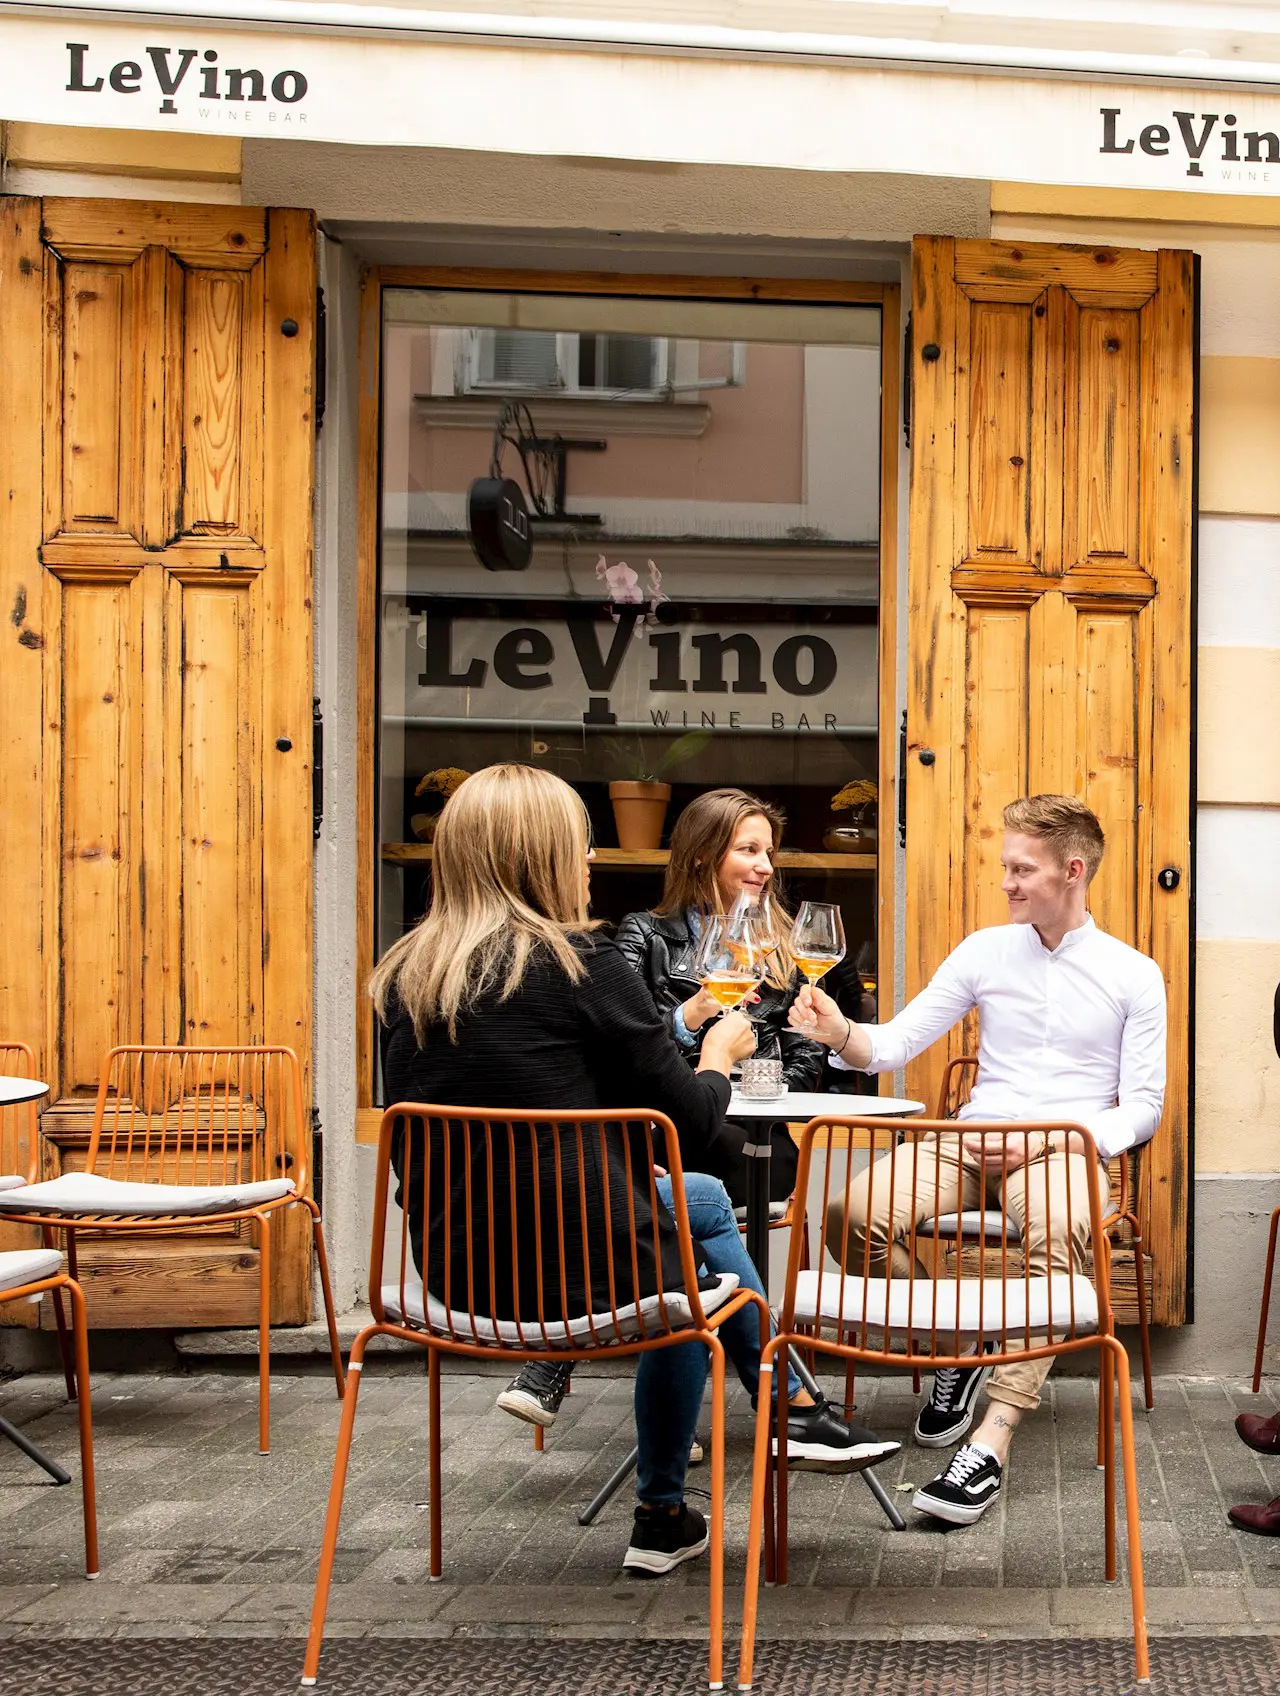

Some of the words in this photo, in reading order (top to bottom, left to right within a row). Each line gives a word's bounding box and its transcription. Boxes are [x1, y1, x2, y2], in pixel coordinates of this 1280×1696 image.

[66, 43, 308, 114] LeVino
[199, 108, 252, 121] WINE
[268, 112, 309, 123] BAR
[1221, 170, 1270, 182] WINE
[417, 600, 838, 725] LeVino
[650, 709, 742, 729] WINE
[771, 712, 838, 731] BAR
